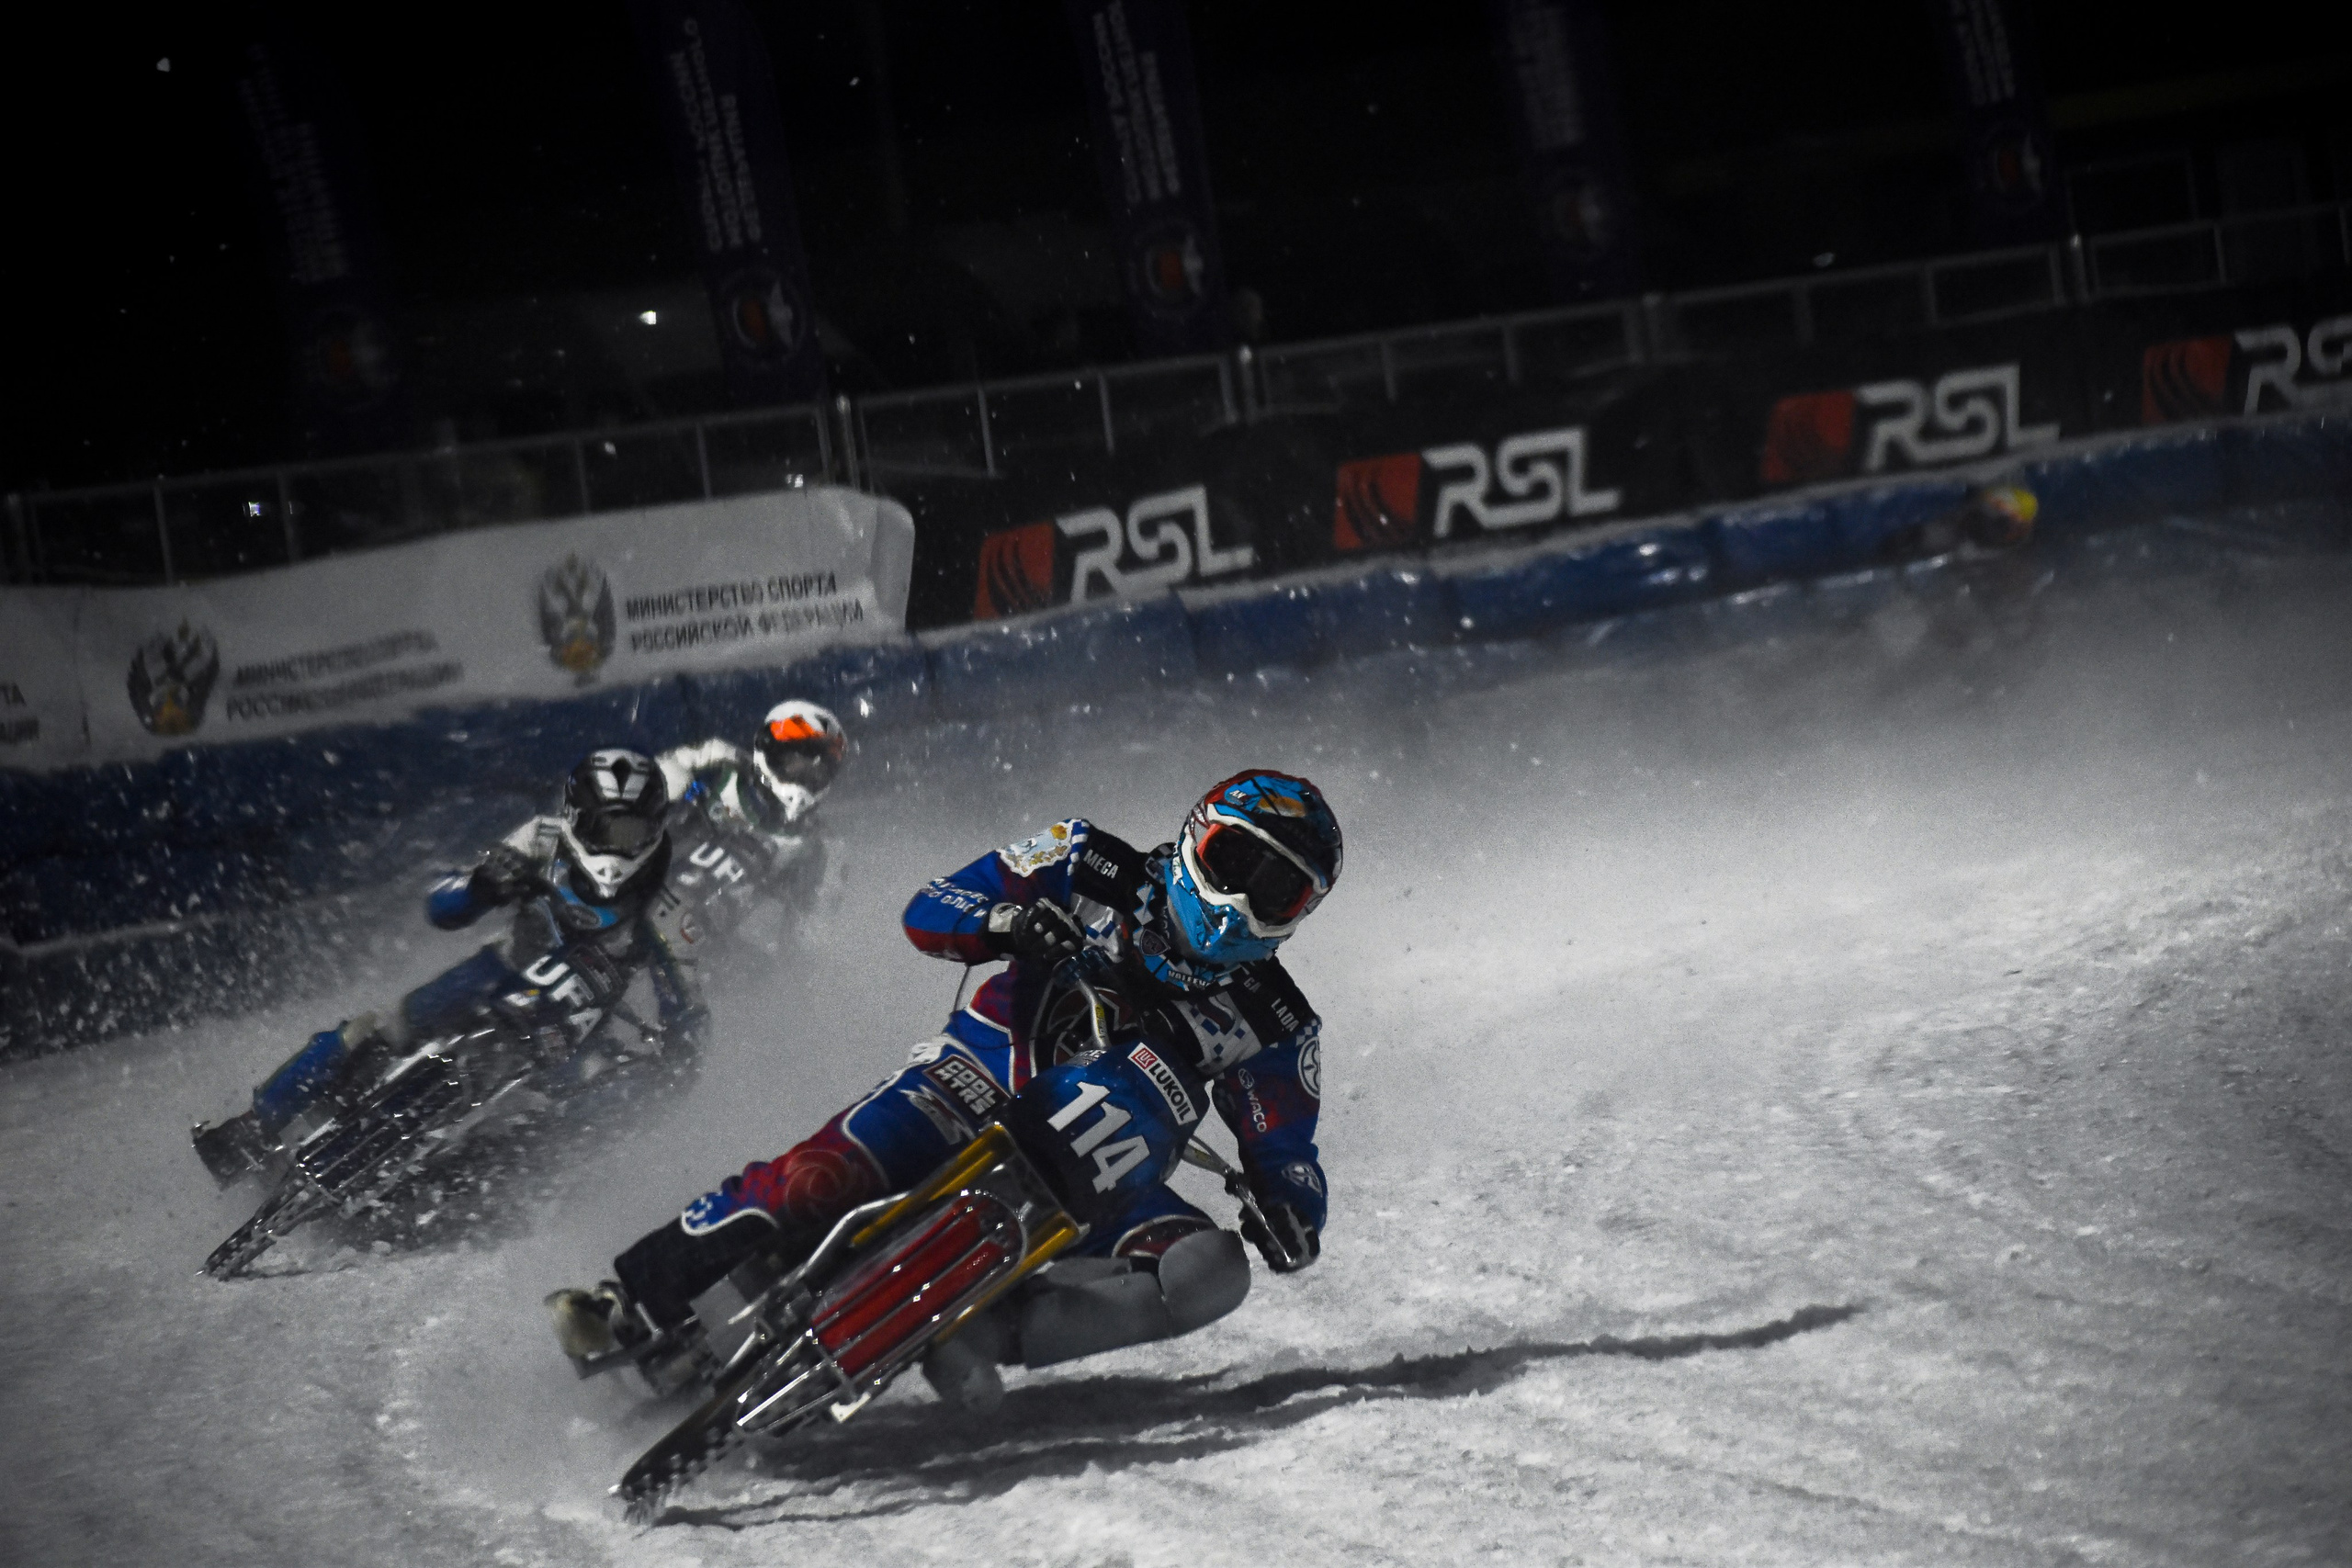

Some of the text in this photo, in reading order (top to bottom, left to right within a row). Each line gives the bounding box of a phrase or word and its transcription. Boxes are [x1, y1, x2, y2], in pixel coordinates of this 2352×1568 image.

[1857, 365, 2061, 471] RSL
[1422, 425, 1621, 537] RSL
[1056, 483, 1254, 604] RSL
[1083, 849, 1119, 879] MEGA
[1271, 998, 1300, 1032] LADA
[944, 1060, 996, 1105] COOL
[1148, 1063, 1191, 1122] LUKOIL
[1047, 1081, 1149, 1194] 114
